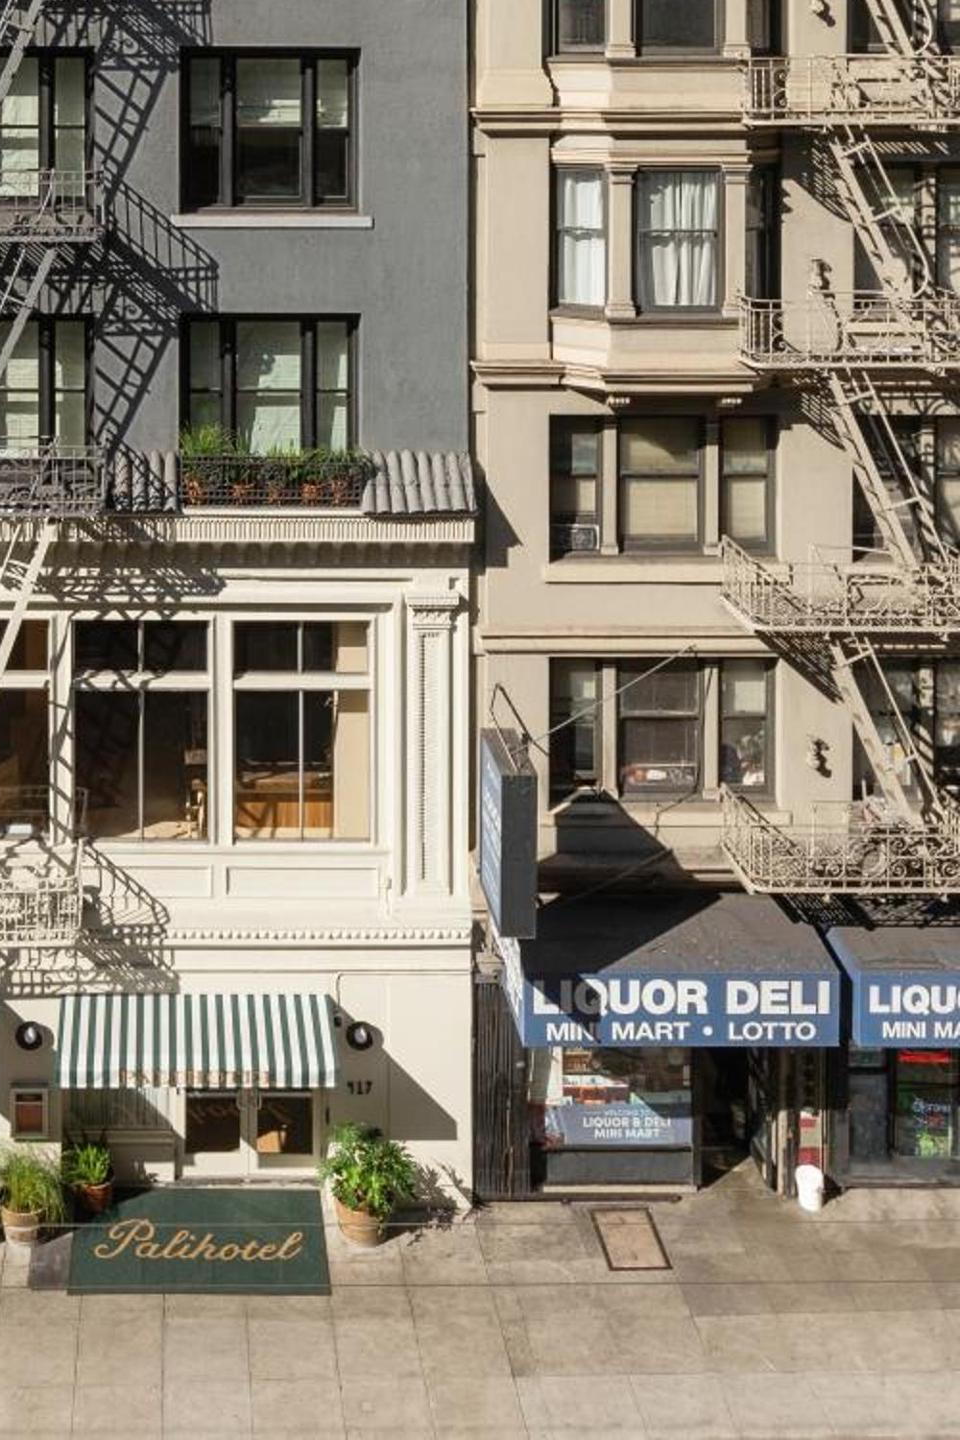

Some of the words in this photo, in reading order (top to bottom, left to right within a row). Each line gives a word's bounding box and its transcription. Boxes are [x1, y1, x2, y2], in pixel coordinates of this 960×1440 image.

[533, 978, 708, 1017] LIQUOR
[726, 980, 830, 1015] DELI
[869, 984, 960, 1016] LIQU
[612, 1021, 690, 1041] MART
[728, 1020, 817, 1041] LOTTO
[882, 1021, 927, 1040] MINI
[94, 1218, 304, 1261] Palihotel
